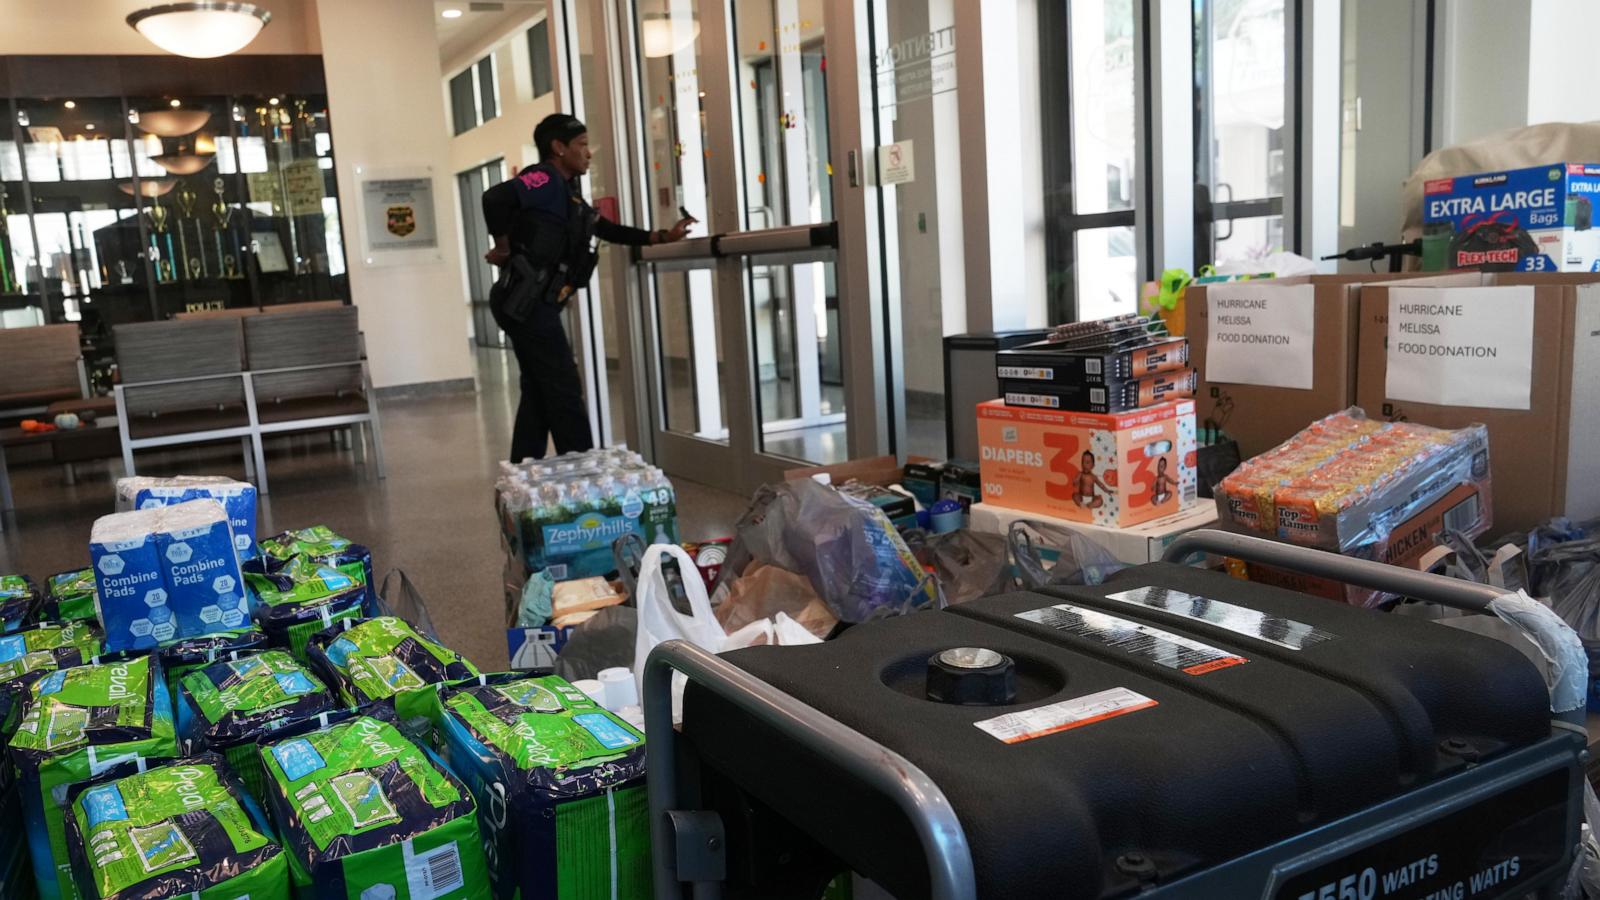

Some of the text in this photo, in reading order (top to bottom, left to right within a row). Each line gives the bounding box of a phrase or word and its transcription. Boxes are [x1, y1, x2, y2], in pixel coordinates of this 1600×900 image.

[1431, 188, 1556, 218] EXTRA LARGE
[1529, 212, 1559, 226] Bags
[1525, 257, 1545, 272] 33
[1217, 299, 1268, 310] HURRICANE
[1399, 303, 1464, 316] HURRICANE
[1217, 315, 1251, 326] MELISSA
[1399, 322, 1441, 335] MELISSA
[1217, 332, 1290, 345] FOOD DONATION
[1398, 342, 1497, 358] FOOD DONATION
[982, 446, 1043, 467] DIAPERS
[1043, 432, 1080, 501] 3
[1127, 447, 1157, 509] 3
[984, 481, 1003, 496] 100
[649, 489, 670, 506] 48
[1279, 507, 1299, 520] Top
[1279, 517, 1319, 531] Ramen
[547, 520, 633, 545] Zephyrhills
[171, 558, 225, 576] Combine
[102, 571, 158, 588] Combine
[173, 572, 204, 587] Pads
[219, 579, 228, 588] 20
[105, 585, 136, 599] Pads
[151, 592, 161, 601] 20
[1382, 854, 1440, 895] WATTS
[1469, 856, 1521, 896] WATTS
